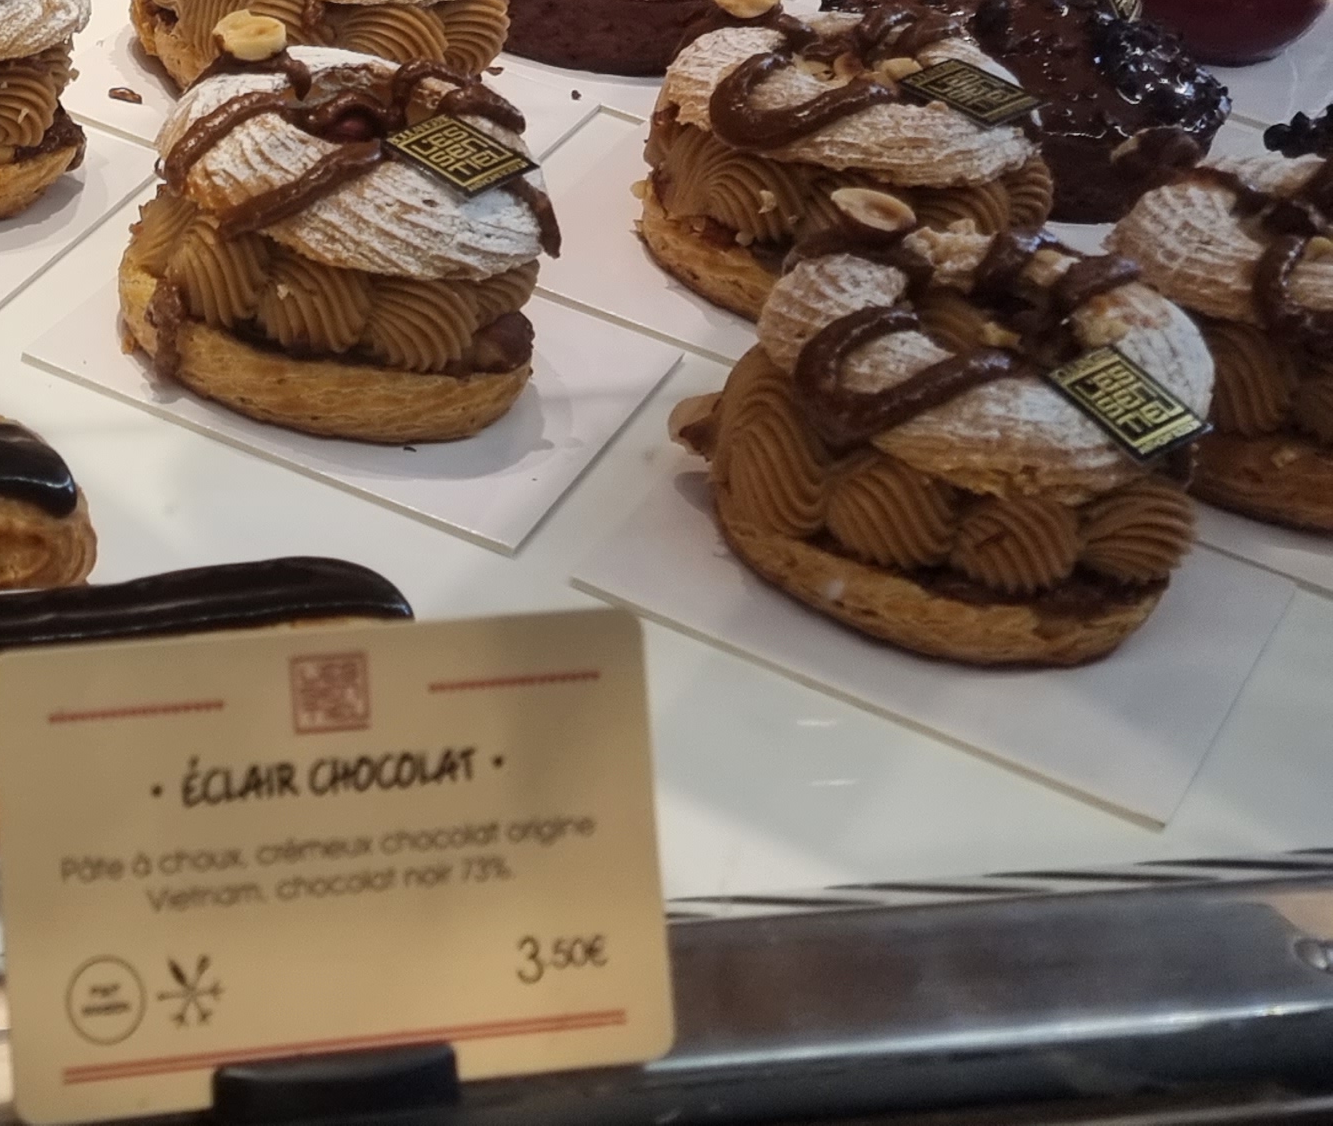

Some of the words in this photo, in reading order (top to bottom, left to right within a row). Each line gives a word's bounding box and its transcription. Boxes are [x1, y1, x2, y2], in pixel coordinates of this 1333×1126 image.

[182, 755, 300, 808] ÉCLAIR
[308, 746, 476, 796] CHOCOLAT
[61, 853, 124, 884] Pâte
[132, 851, 152, 878] à
[255, 836, 371, 867] crémeux
[381, 820, 499, 855] chocolat
[505, 815, 596, 847] origine
[276, 866, 395, 900] chocolat
[404, 862, 453, 888] noir
